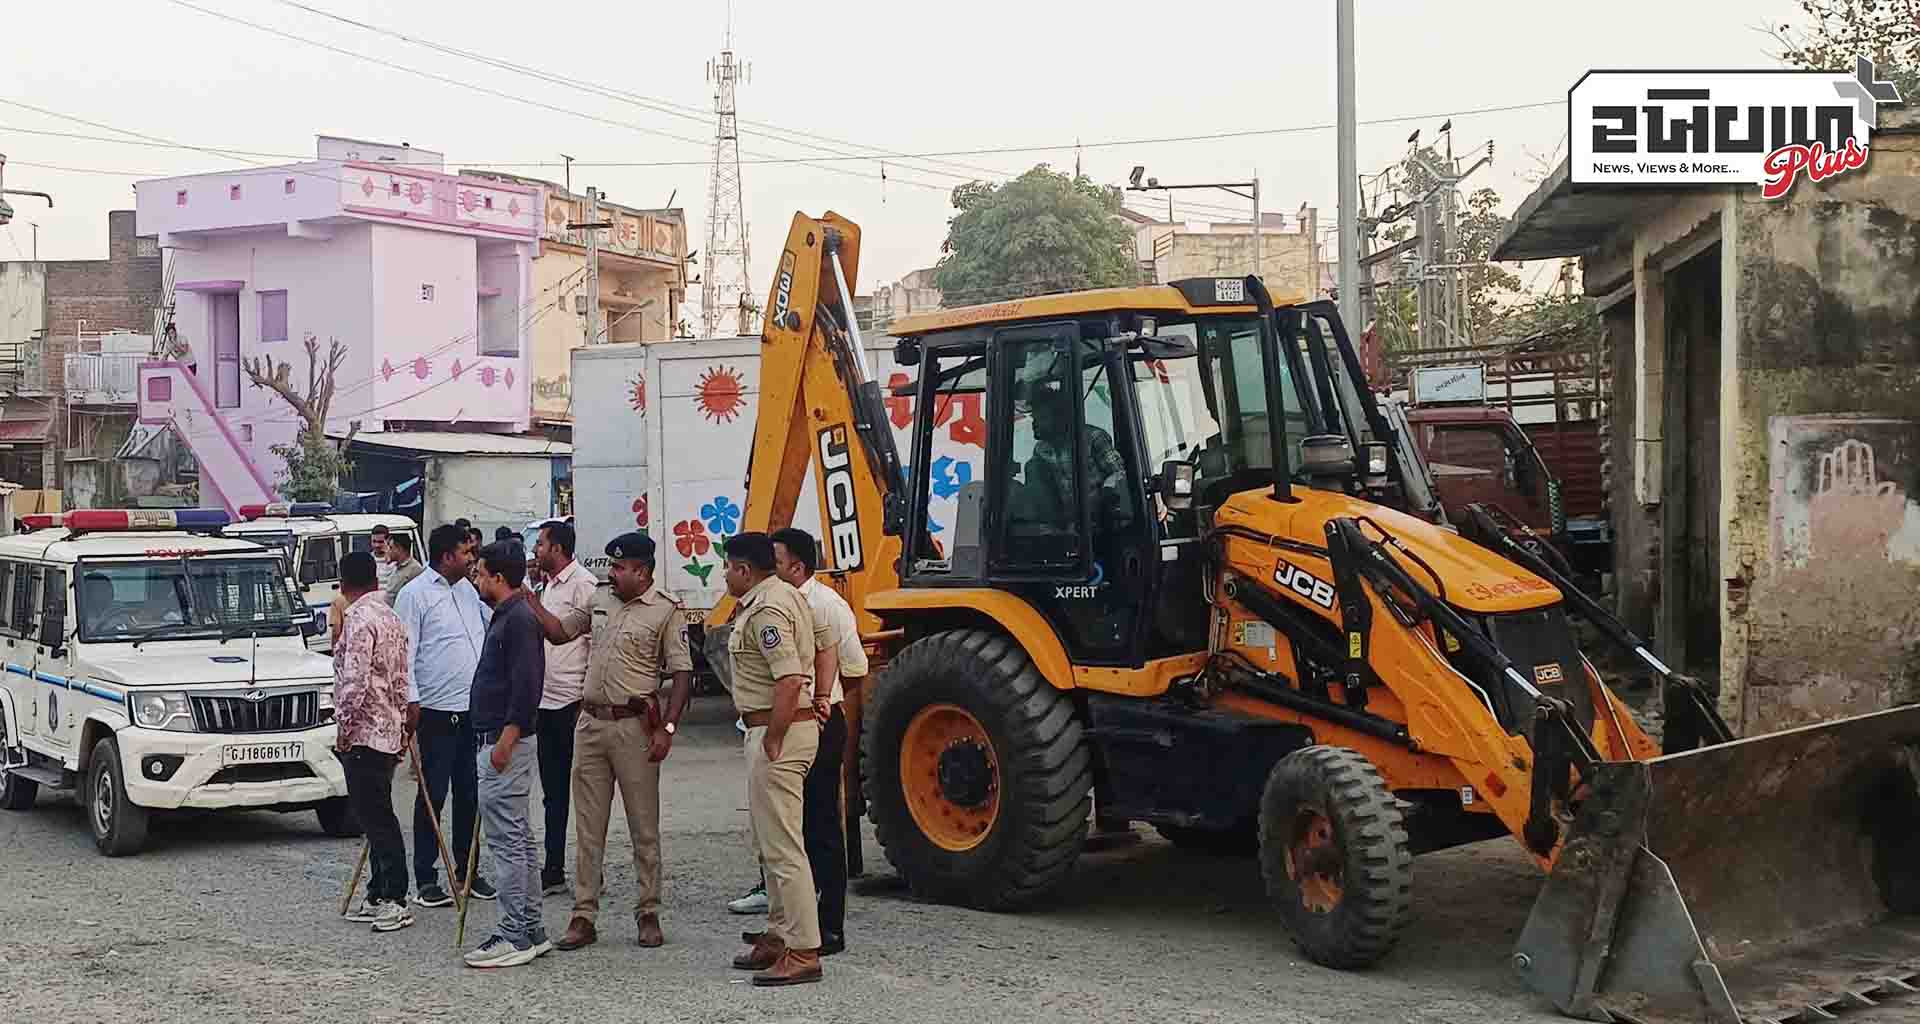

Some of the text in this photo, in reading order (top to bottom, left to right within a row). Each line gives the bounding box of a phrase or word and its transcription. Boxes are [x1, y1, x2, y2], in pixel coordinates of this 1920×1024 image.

[820, 430, 862, 571] JCB
[1055, 586, 1098, 599] XPERT
[1275, 564, 1335, 608] JCB
